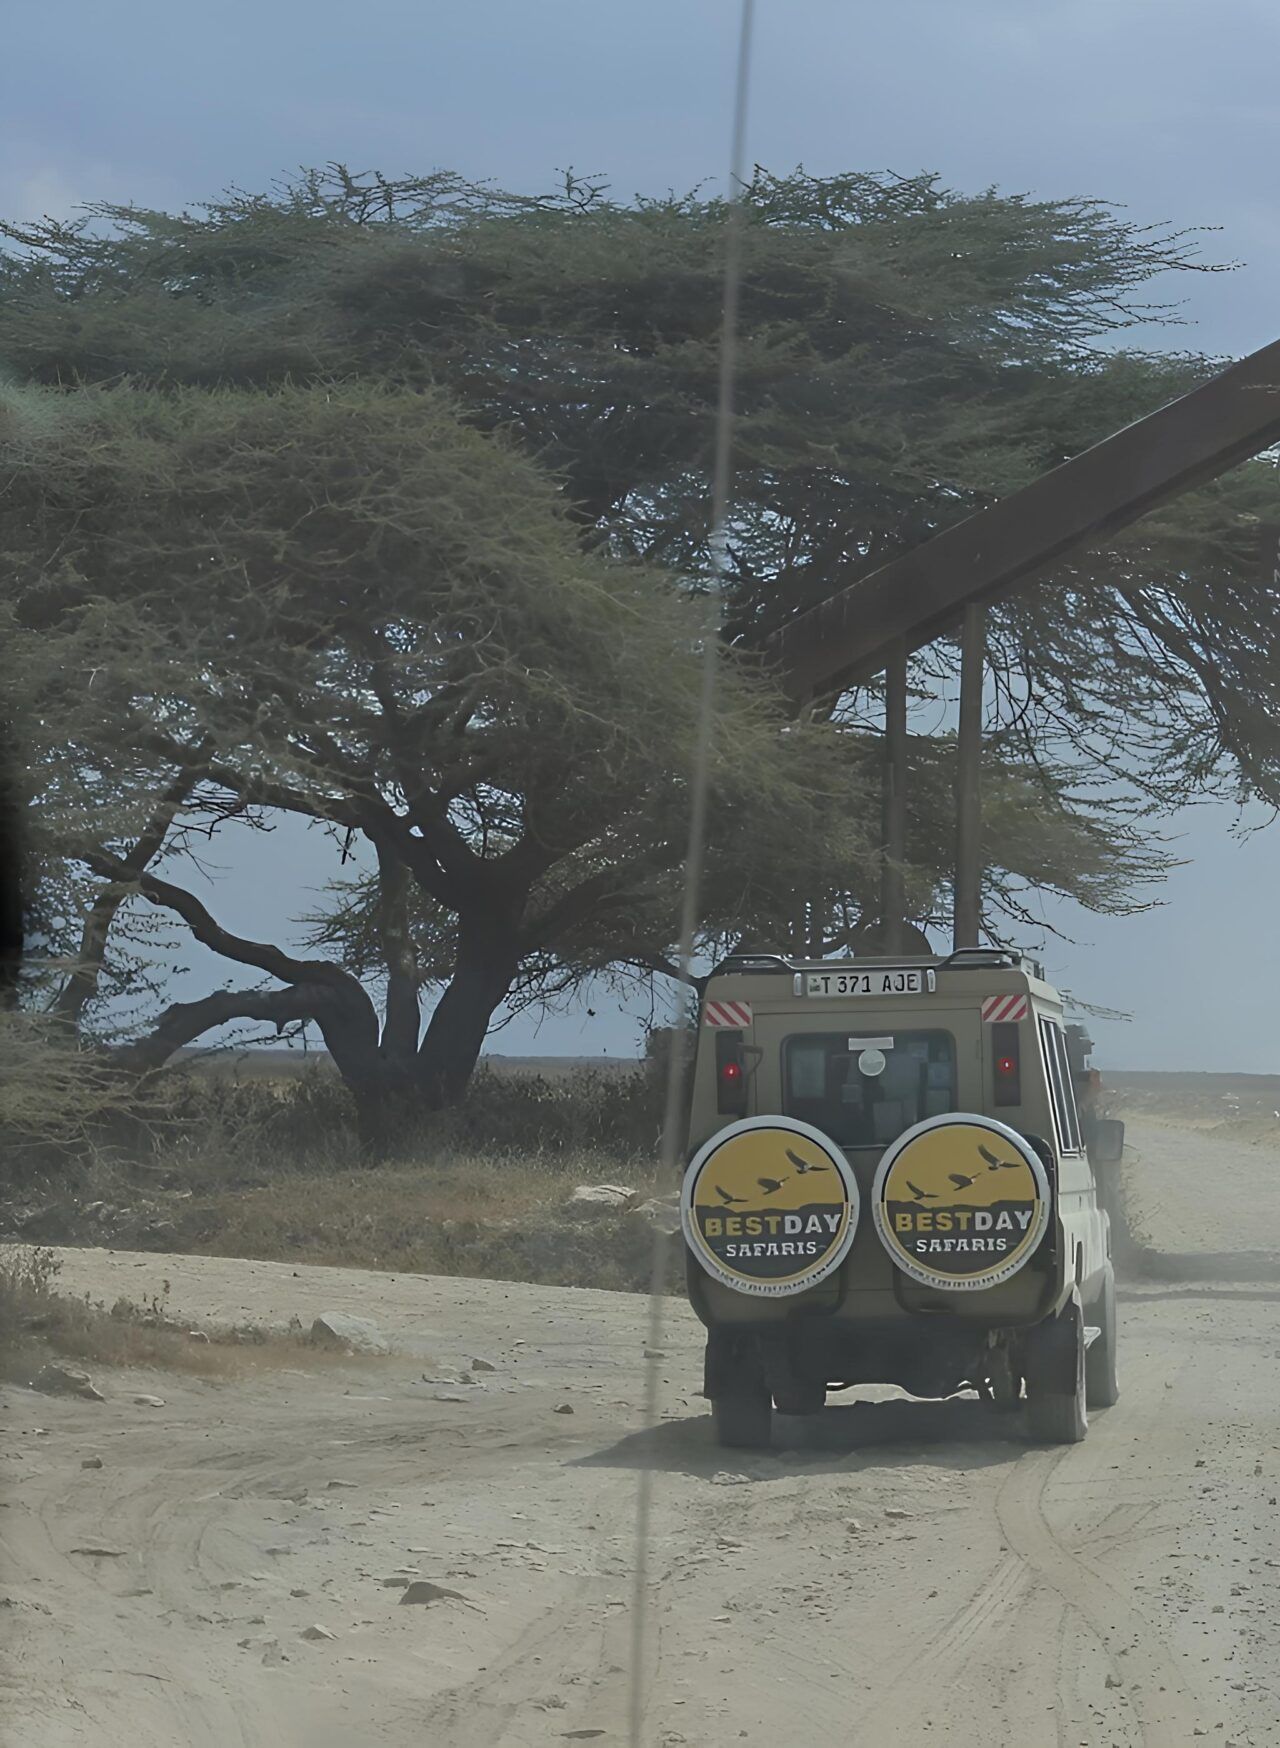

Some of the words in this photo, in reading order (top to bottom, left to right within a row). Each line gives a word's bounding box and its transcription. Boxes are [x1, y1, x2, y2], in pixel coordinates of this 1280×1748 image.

[821, 976, 831, 994] T
[837, 975, 871, 993] 371
[881, 973, 918, 992] AJE
[726, 1241, 817, 1257] SAFARIS
[916, 1238, 1007, 1252] SAFARIS
